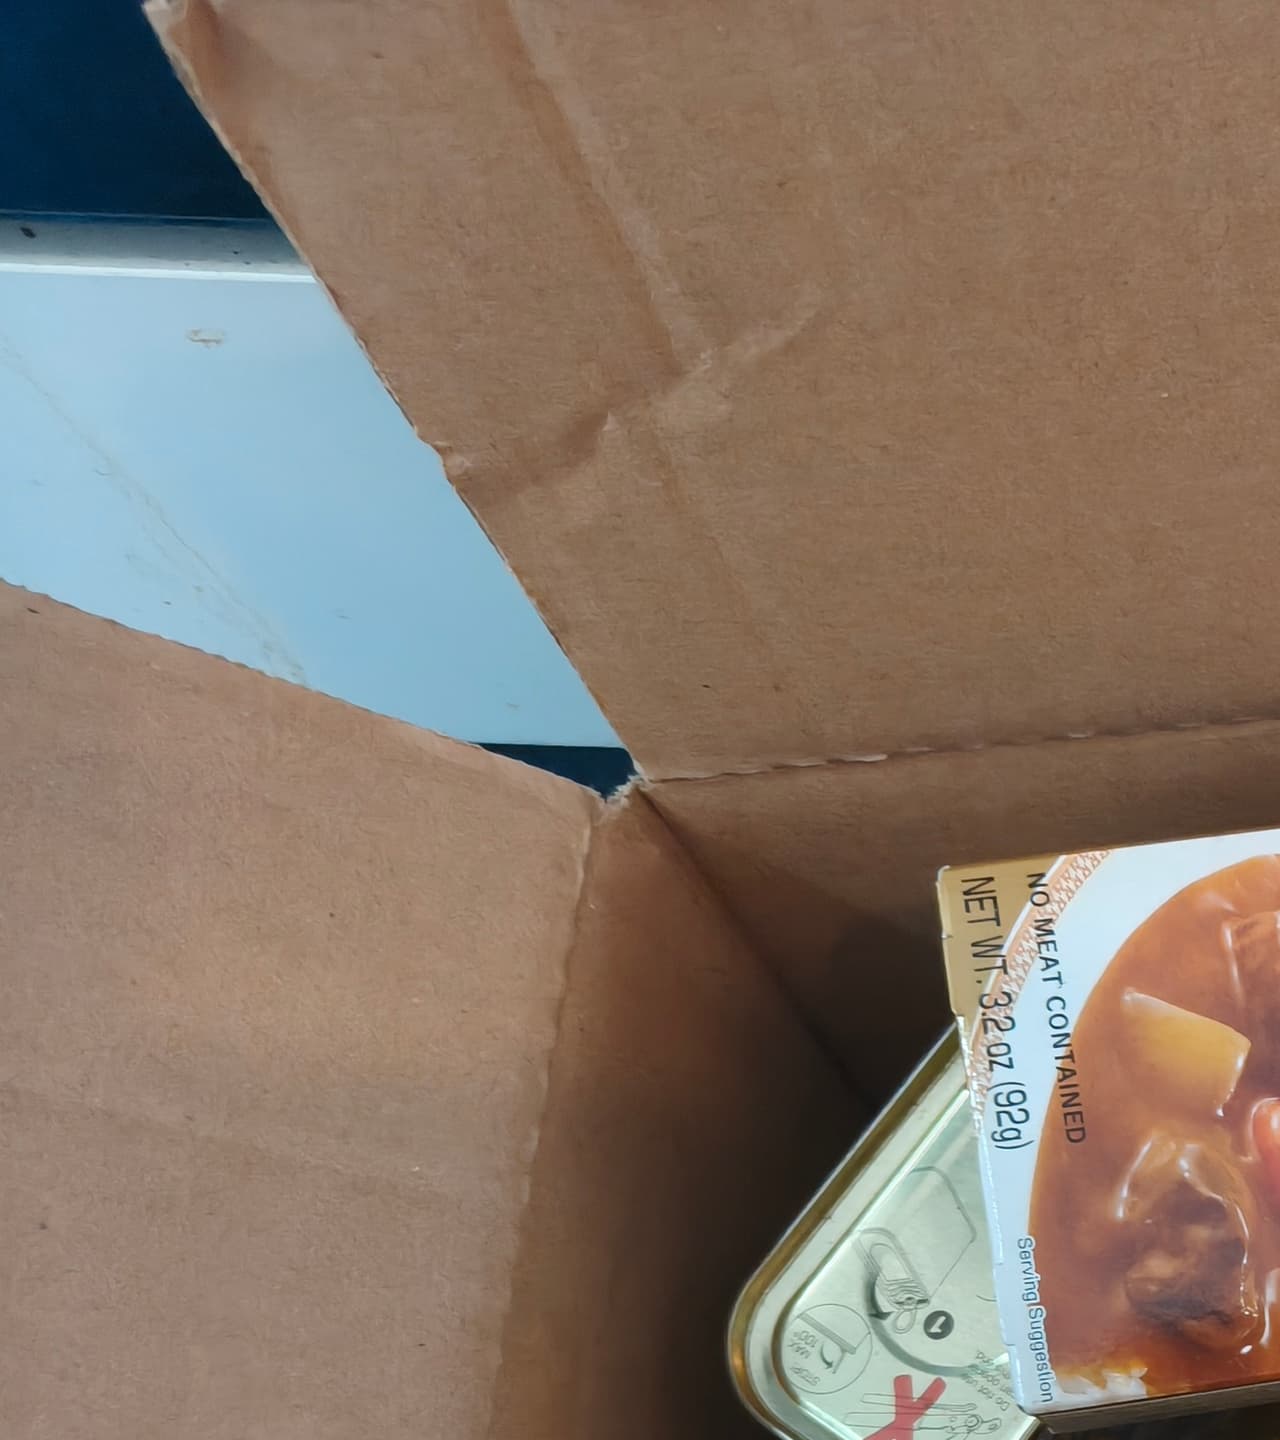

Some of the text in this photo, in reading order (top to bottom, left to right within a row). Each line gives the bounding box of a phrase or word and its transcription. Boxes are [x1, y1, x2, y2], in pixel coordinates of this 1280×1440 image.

[960, 875, 1000, 934] NET
[988, 1078, 1035, 1152] (92g)
[1025, 872, 1089, 1146] NO MEAT CONTAINED
[1016, 1236, 1054, 1404] Serving Suggestion
